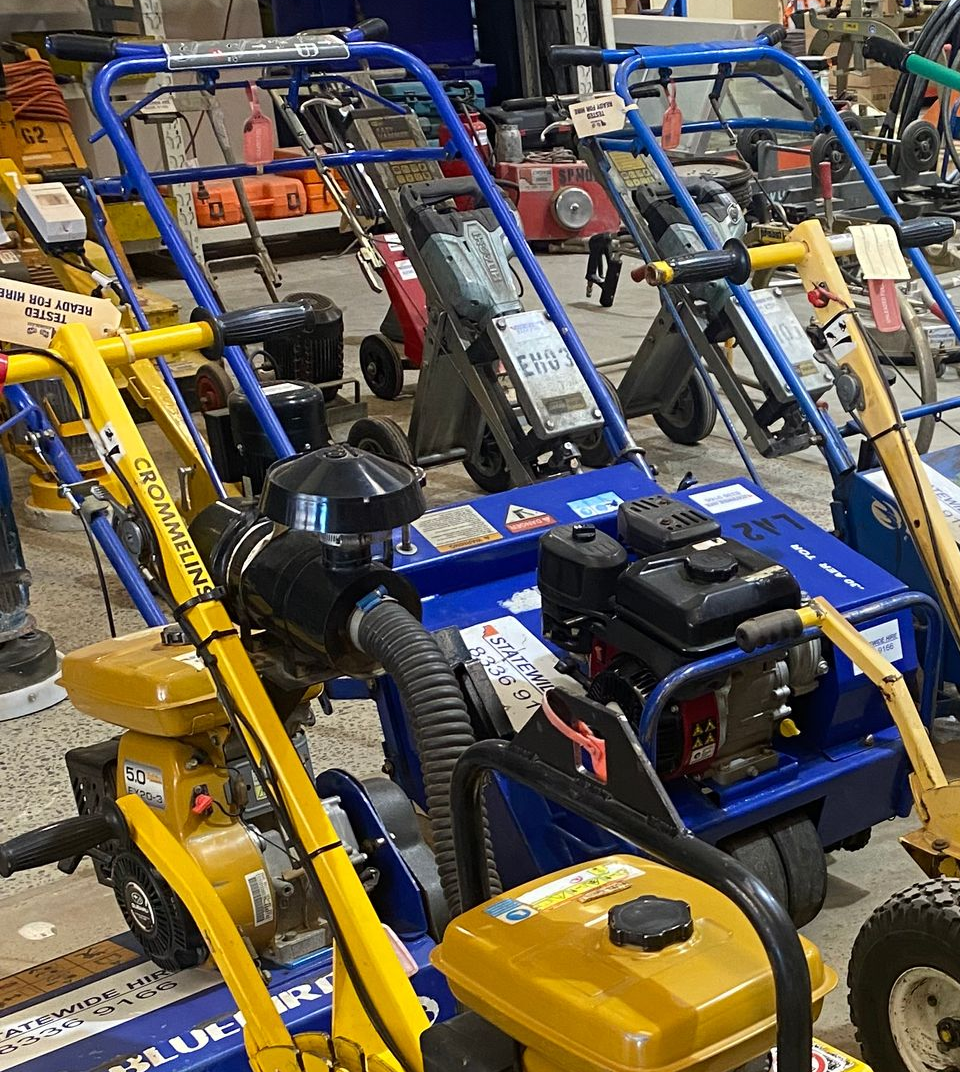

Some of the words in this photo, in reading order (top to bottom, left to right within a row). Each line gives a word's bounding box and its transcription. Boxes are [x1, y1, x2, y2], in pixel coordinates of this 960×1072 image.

[587, 111, 605, 119] TESTED
[0, 287, 25, 303] HIRE
[29, 293, 51, 310] FOR
[25, 307, 67, 324] TESTED
[55, 297, 93, 317] READY
[134, 457, 214, 597] CROMMELINS
[490, 636, 555, 691] STATEWI
[469, 646, 517, 686] 8336
[513, 689, 542, 710] 91
[126, 766, 146, 786] 5.0
[0, 988, 121, 1039] ATEWIDE
[126, 969, 173, 990] HIR
[93, 981, 178, 1016] 9166
